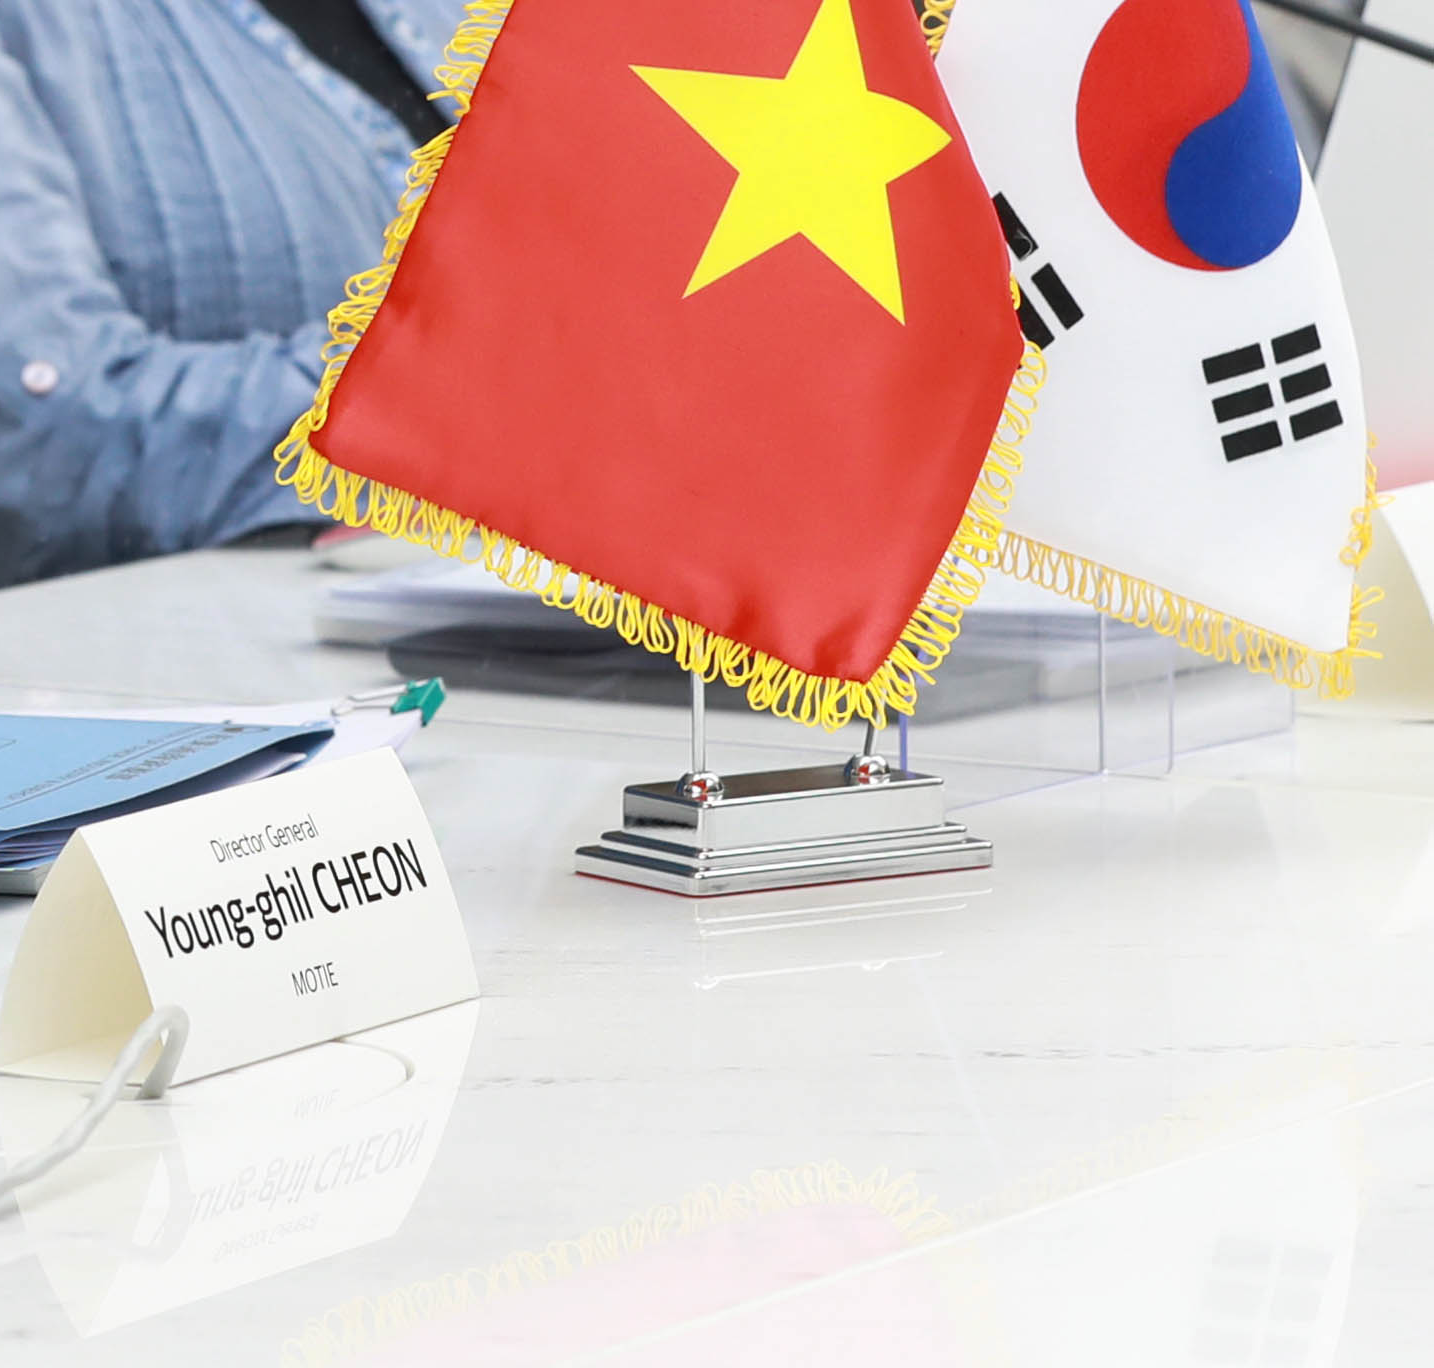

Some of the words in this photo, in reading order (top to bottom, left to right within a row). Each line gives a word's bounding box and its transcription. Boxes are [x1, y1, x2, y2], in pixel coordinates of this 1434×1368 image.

[210, 832, 266, 863] Director
[265, 814, 319, 848] General
[144, 866, 314, 958] Young-ghil
[311, 838, 427, 914] CHEON
[291, 961, 339, 997] MOTIE
